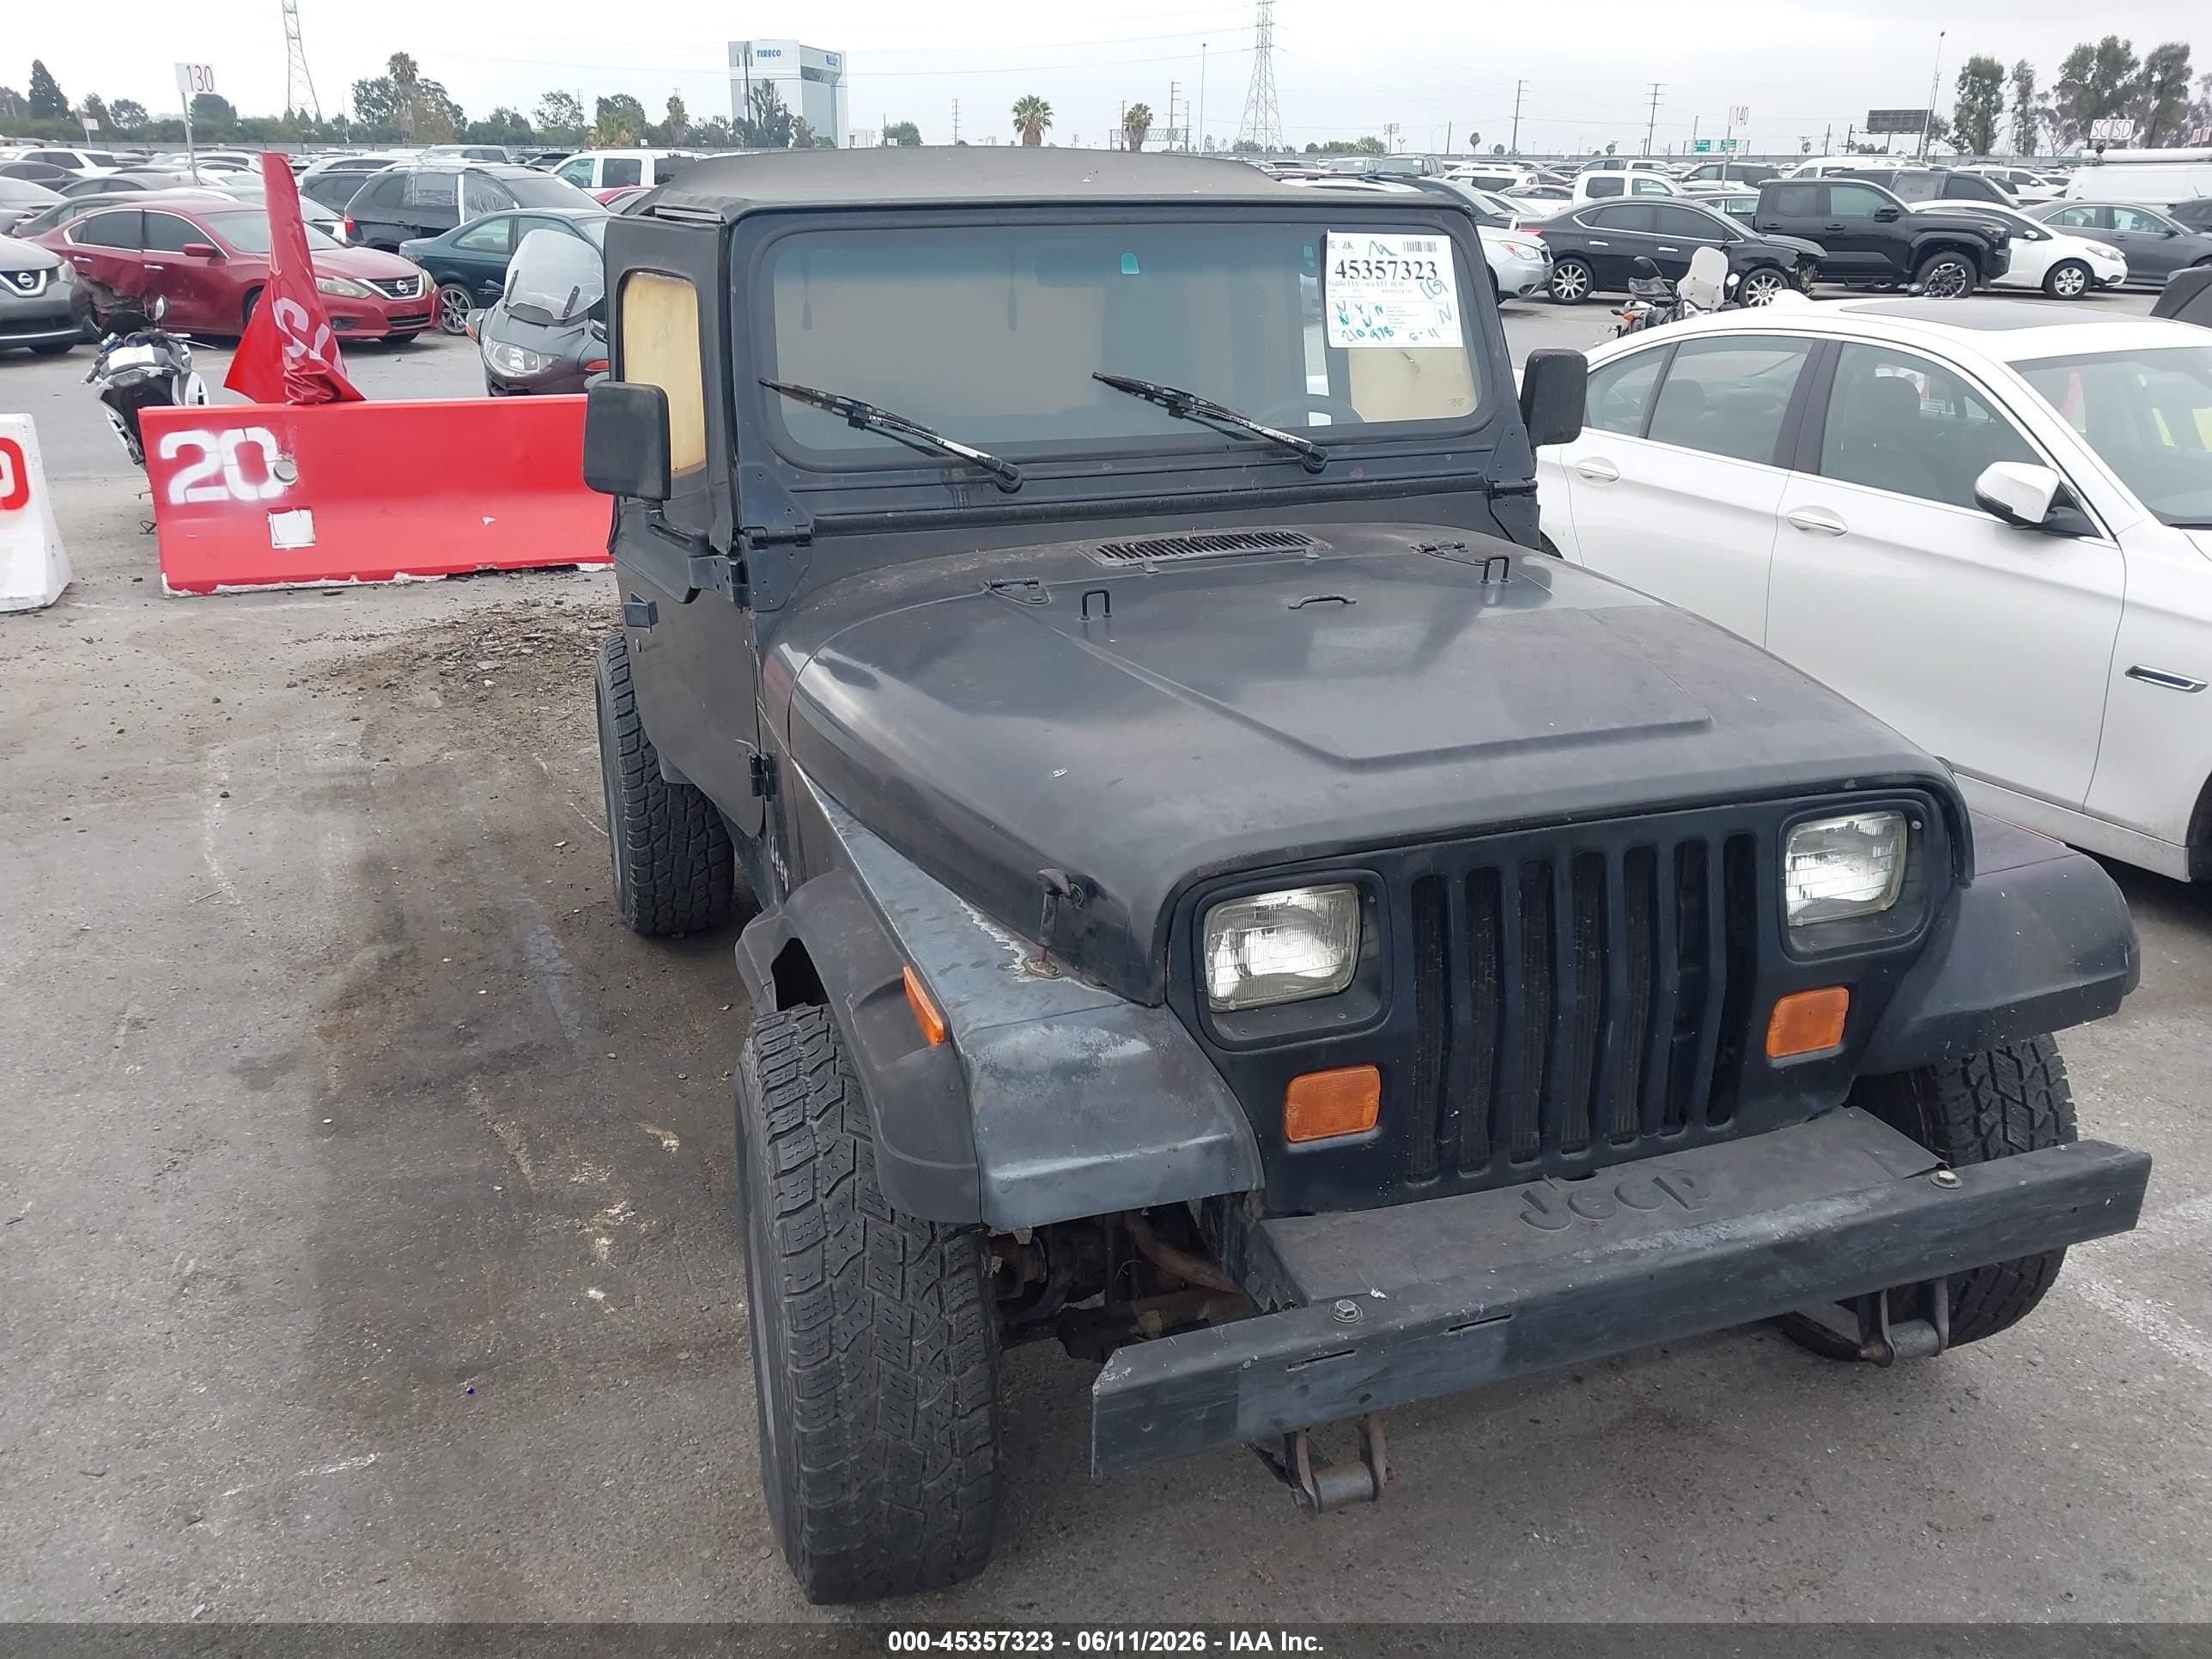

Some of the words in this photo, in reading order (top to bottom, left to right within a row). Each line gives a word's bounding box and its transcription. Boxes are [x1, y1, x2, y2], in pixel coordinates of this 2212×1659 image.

[757, 49, 781, 58] TIRECO
[185, 64, 214, 93] 130
[1735, 106, 1749, 125] 140
[1334, 259, 1437, 280] 45357323
[160, 427, 282, 505] 20
[1519, 1170, 1714, 1232] Jeep
